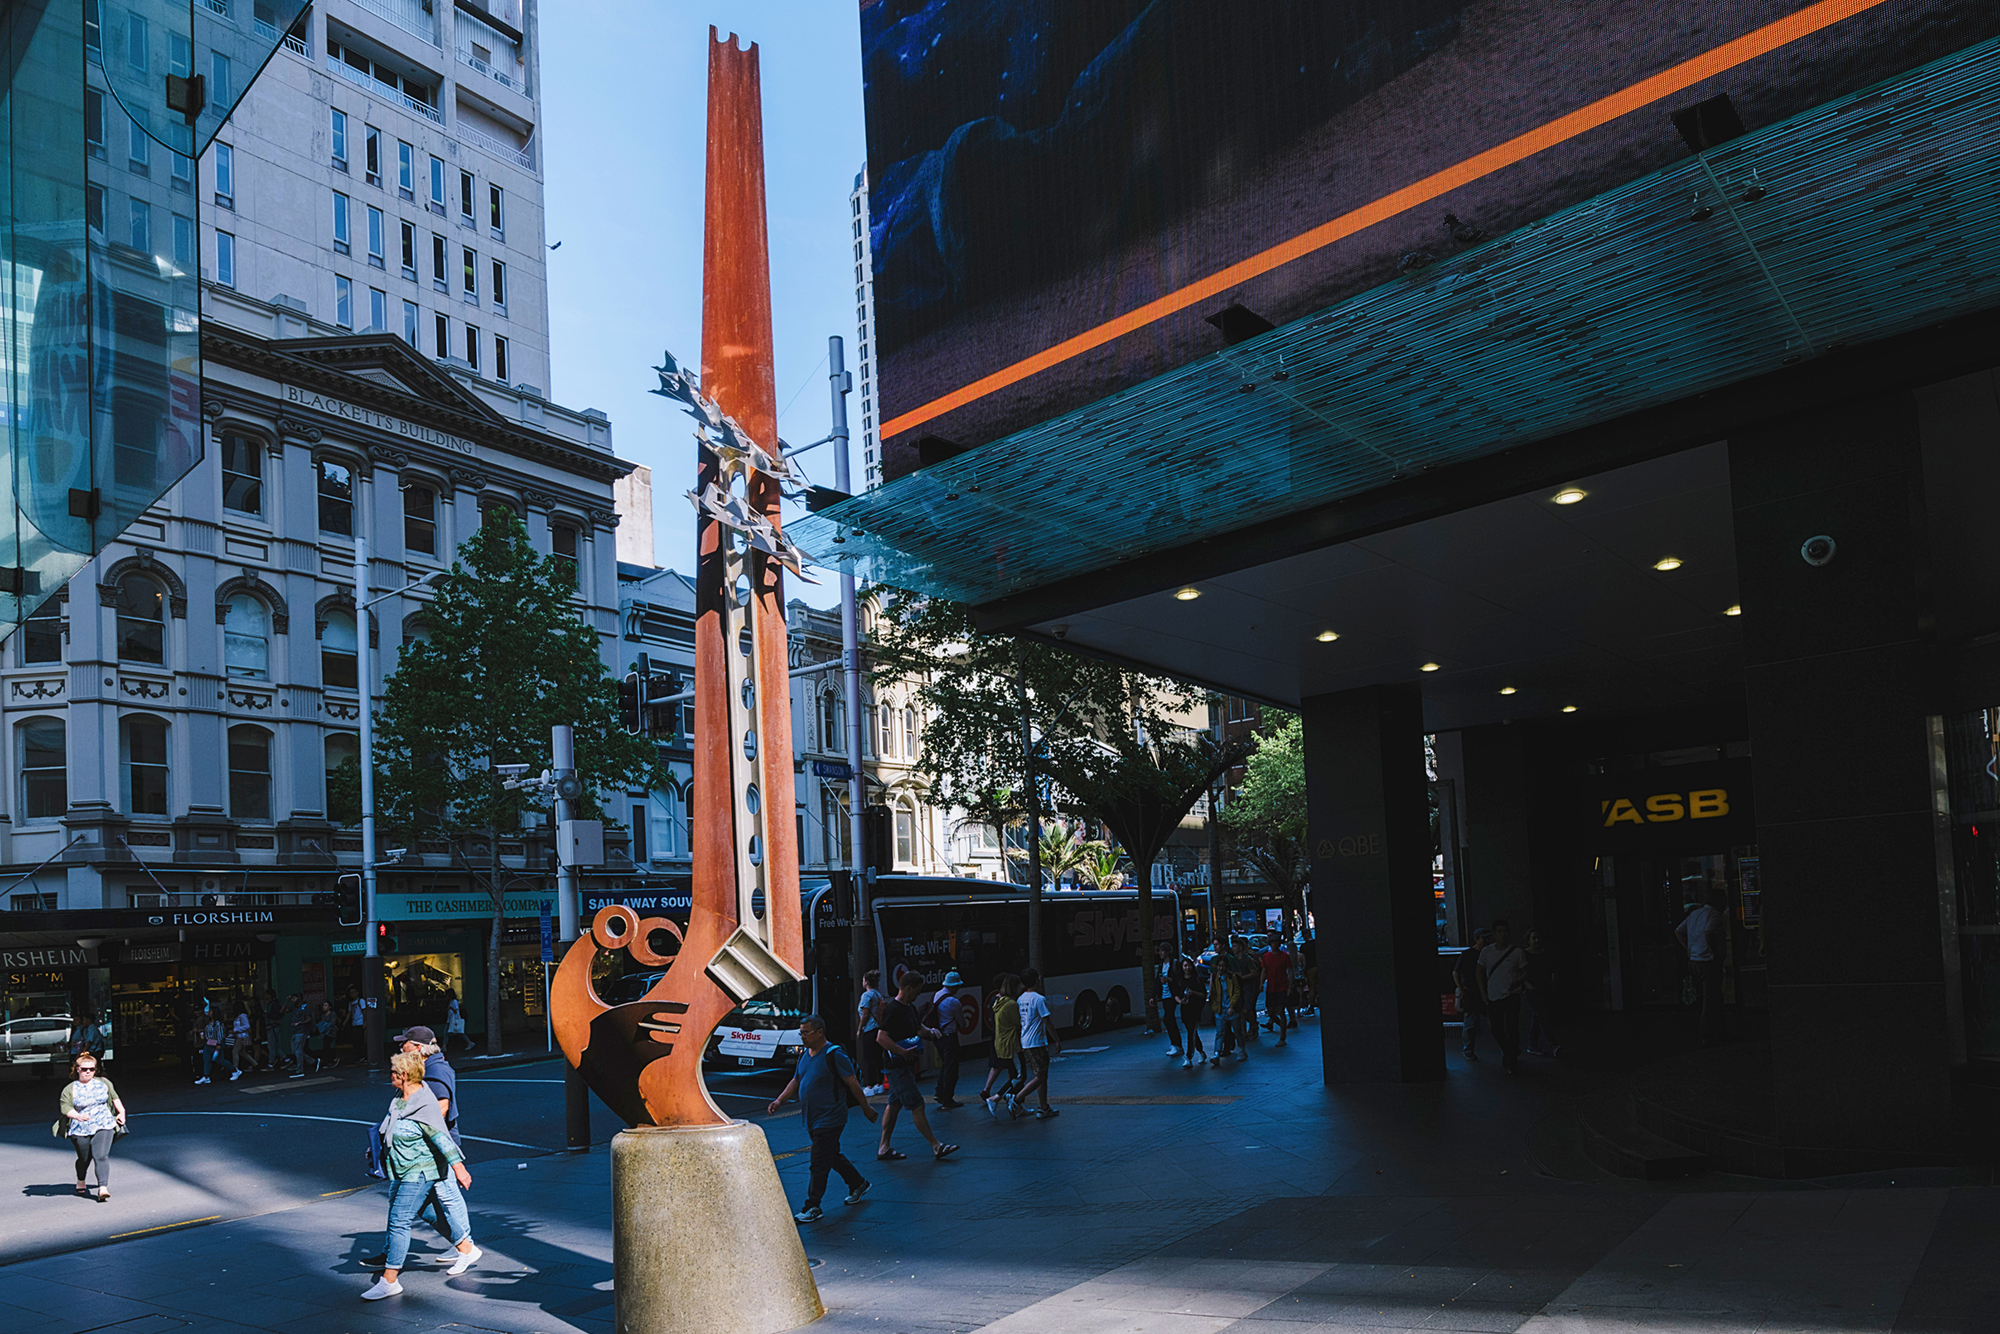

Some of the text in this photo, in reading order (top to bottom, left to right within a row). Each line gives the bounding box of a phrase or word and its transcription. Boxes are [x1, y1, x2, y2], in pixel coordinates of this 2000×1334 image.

[399, 420, 473, 455] BUILDING
[822, 764, 845, 776] SWANSON
[1601, 788, 1731, 828] ASB
[1338, 834, 1381, 857] QBE
[406, 899, 555, 913] THE CASHMER COMPAY
[622, 897, 657, 908] AWAY
[821, 903, 833, 913] 119
[173, 911, 274, 925] FLORSHEIM
[818, 918, 836, 928] Free
[130, 947, 170, 961] FLORSHEIM
[194, 943, 251, 958] HEIM
[332, 943, 343, 953] THE
[903, 942, 926, 957] Free
[927, 939, 951, 955] Wi-Fi
[2, 949, 88, 967] RSHEIM
[730, 1031, 761, 1041] SkyBus
